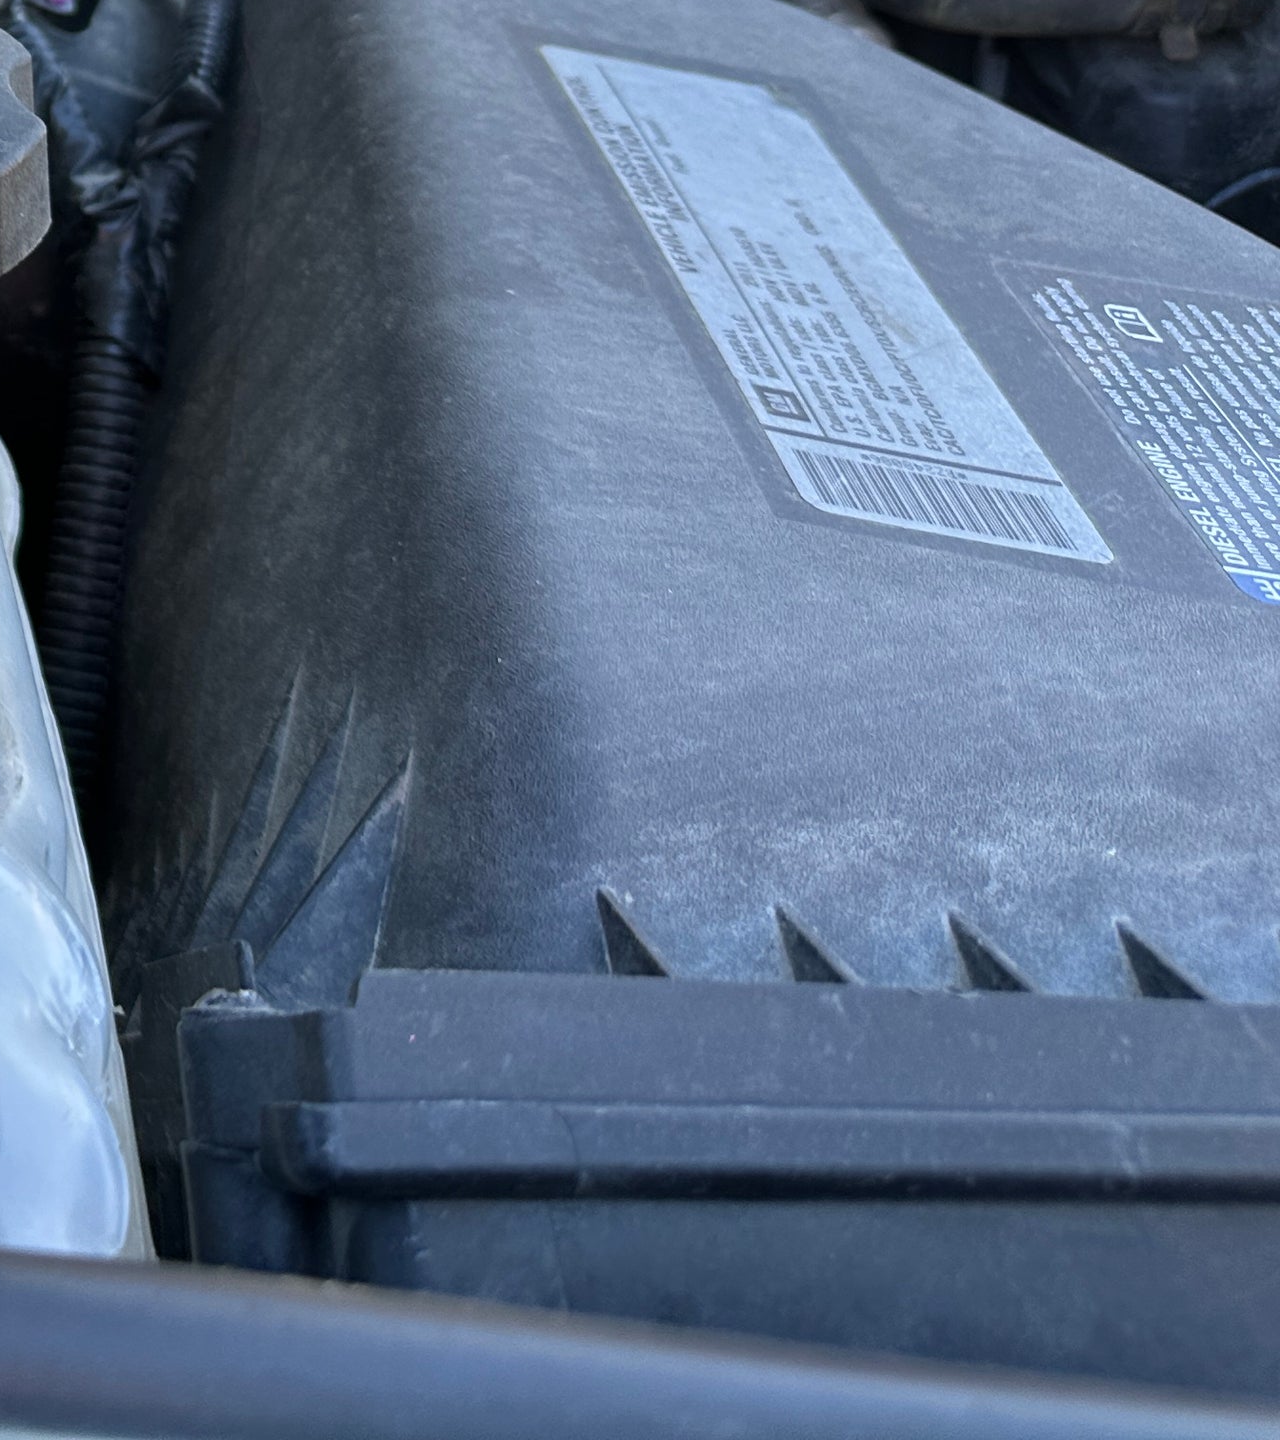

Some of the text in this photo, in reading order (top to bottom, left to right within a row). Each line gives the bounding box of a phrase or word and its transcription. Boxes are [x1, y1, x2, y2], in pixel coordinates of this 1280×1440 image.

[603, 138, 657, 205] EMISSION
[614, 123, 689, 221] INFORMATION
[646, 211, 698, 273] VEHICLE
[1067, 316, 1088, 332] not
[1082, 312, 1122, 347] system
[723, 329, 760, 375] GENERAL
[731, 315, 780, 378] MOTORS LLC
[1054, 324, 1096, 363] starting
[1080, 335, 1103, 350] Do
[807, 352, 836, 379] class
[829, 355, 858, 383] class
[1089, 367, 1112, 385] use
[1111, 349, 1159, 397] electrical
[1146, 368, 1166, 379] of
[826, 384, 853, 407] EPA
[1104, 388, 1127, 405] not
[1127, 391, 1150, 411] can
[1152, 401, 1170, 411] to
[1158, 382, 1198, 419] Failure
[1197, 402, 1222, 422] can
[848, 386, 895, 442] California
[1119, 409, 1141, 423] Do
[1160, 414, 1193, 441] volts
[909, 418, 945, 451] Evap:
[1143, 414, 1189, 458] damage
[1185, 444, 1207, 457] 12
[1213, 425, 1261, 467] System
[1137, 440, 1200, 501] ENGINE
[1179, 462, 1223, 501] engine
[1199, 462, 1246, 507] nominal
[1238, 511, 1270, 538] than
[1258, 507, 1278, 520] or
[1185, 504, 1249, 565] DIESEL
[1212, 504, 1273, 569] Immediate
